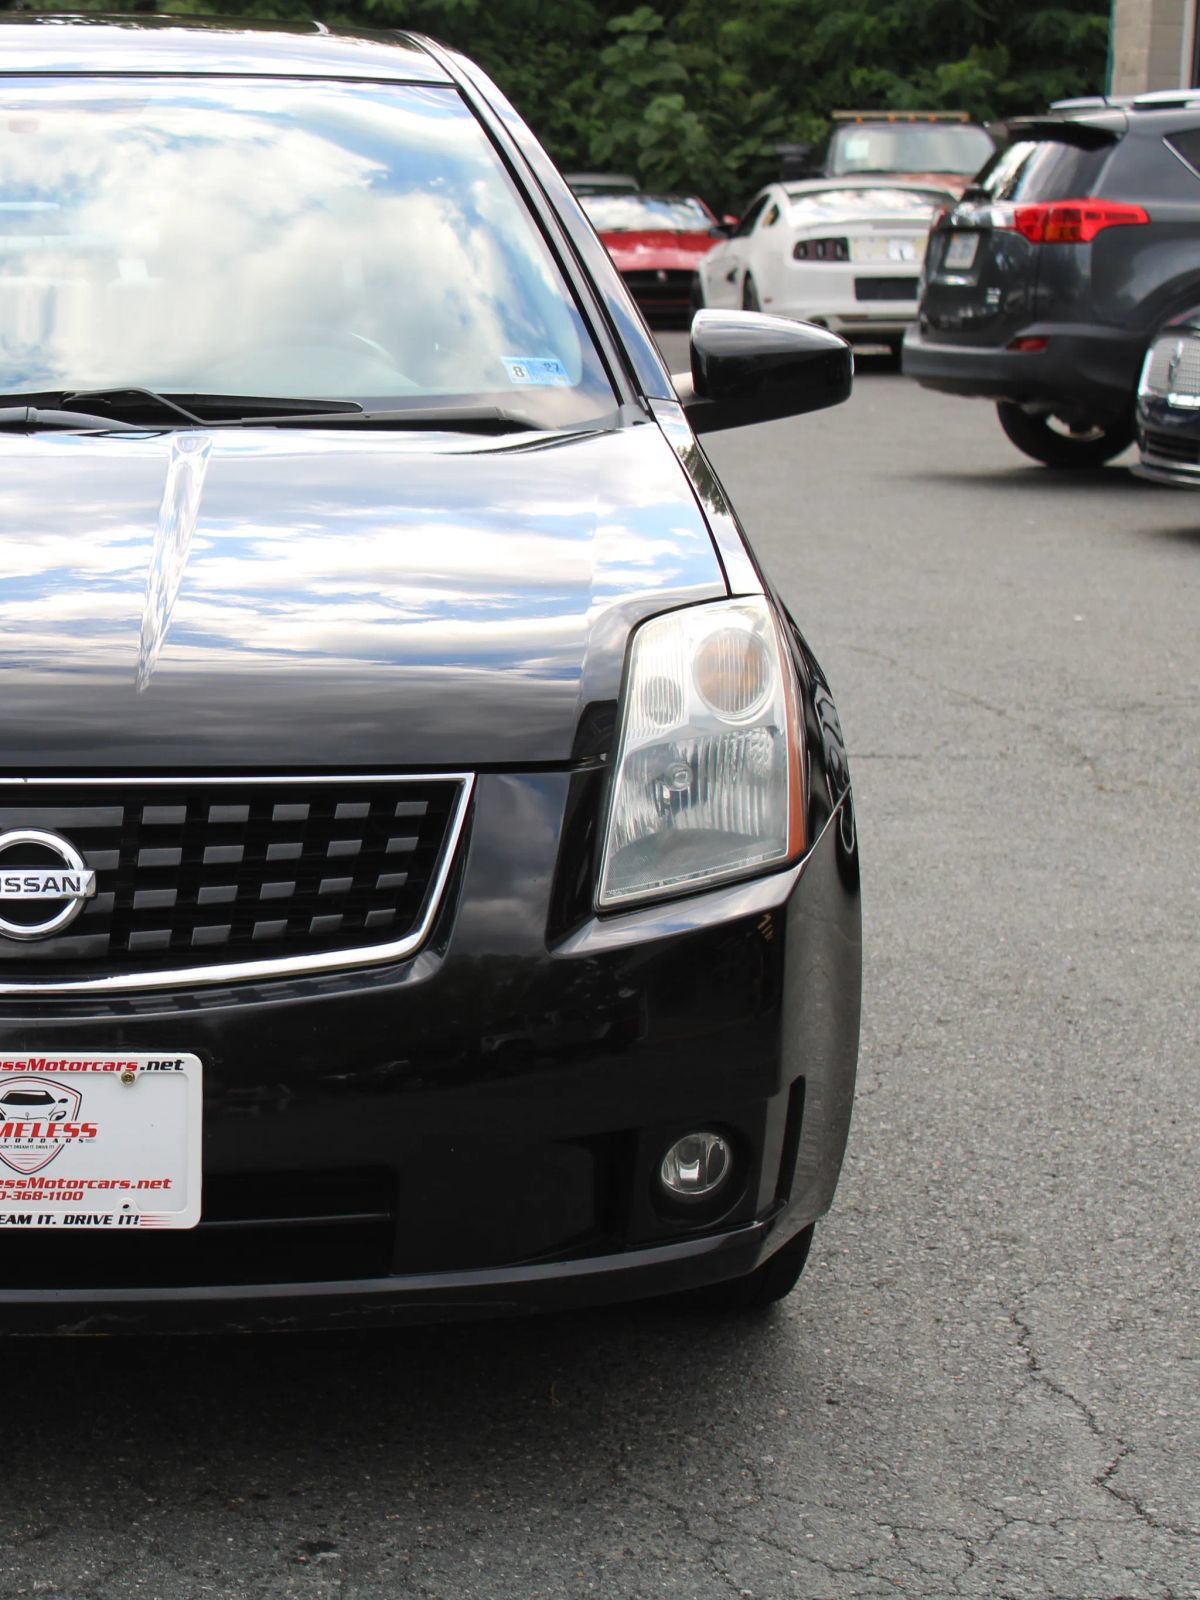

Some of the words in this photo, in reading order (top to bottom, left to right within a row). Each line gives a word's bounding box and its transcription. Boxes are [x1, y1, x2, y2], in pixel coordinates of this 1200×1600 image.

[37, 1214, 57, 1225] IT.
[63, 1214, 114, 1225] DRIVE
[118, 1214, 140, 1225] IT!
